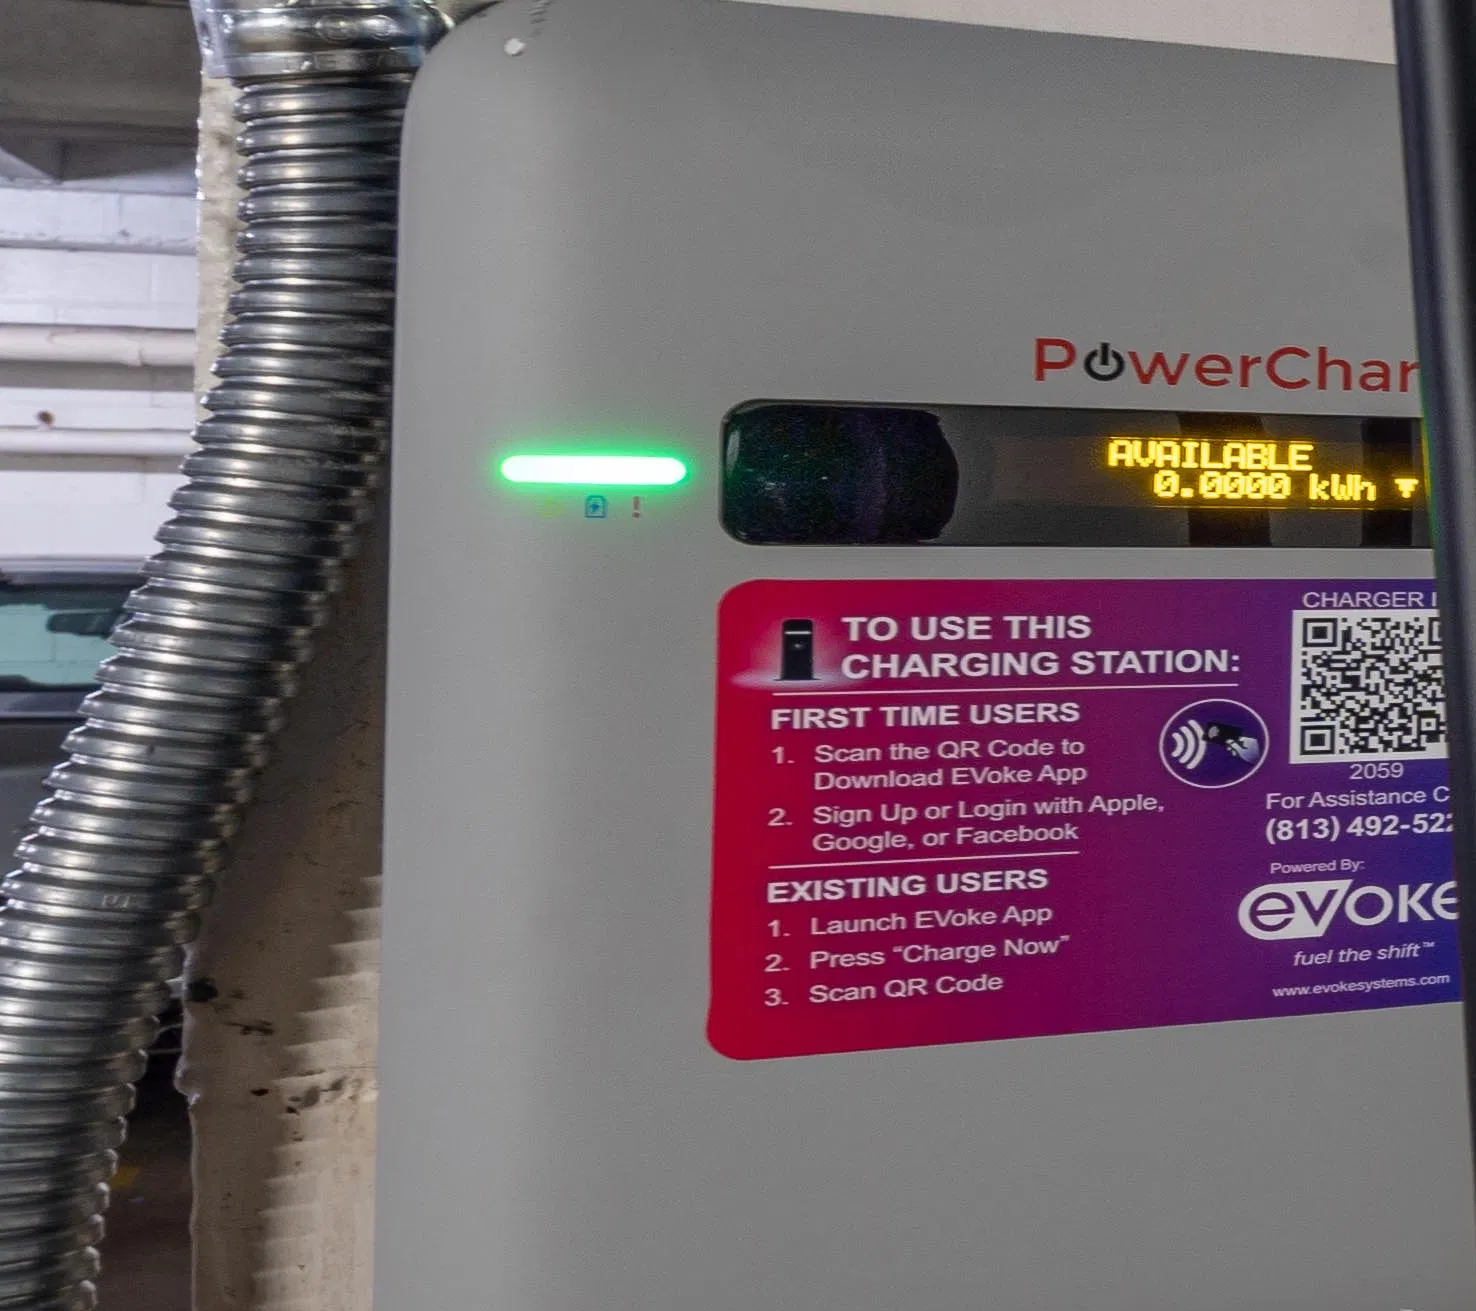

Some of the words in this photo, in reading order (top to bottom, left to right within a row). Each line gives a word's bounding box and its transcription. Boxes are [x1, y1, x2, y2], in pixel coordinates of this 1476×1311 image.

[1033, 337, 1421, 393] PowerChar
[1108, 439, 1313, 471] AVAILABLE
[1154, 470, 1291, 499] 0.0000
[1309, 473, 1377, 501] kWh
[1302, 591, 1424, 608] CHARGER
[840, 617, 898, 642] TO
[910, 616, 993, 641] USE
[1003, 615, 1092, 640] THIS
[840, 652, 1061, 679] CHARGING
[1070, 649, 1240, 675] STATION:
[771, 707, 872, 730] FIRST
[880, 705, 960, 727] TIME
[970, 703, 1080, 725] USERS
[771, 746, 795, 765] 1.
[814, 744, 882, 763] Scan
[889, 743, 930, 761] the
[937, 740, 981, 760] QR
[988, 739, 1055, 758] Code
[1062, 739, 1085, 756] to
[814, 768, 943, 790] Download
[951, 766, 1033, 786] EVoke
[1037, 764, 1088, 786] App
[1349, 762, 1404, 780] 2059
[767, 807, 793, 826] 2.
[813, 805, 872, 827] Sign
[880, 803, 918, 825] Up
[924, 805, 952, 820] or
[958, 799, 1027, 821] Login
[1033, 796, 1083, 815] with
[1088, 794, 1165, 816] Apple,
[1265, 792, 1305, 810] For
[1308, 789, 1427, 808] Assistance
[813, 830, 915, 853] Google,
[921, 832, 951, 847] or
[956, 823, 1080, 845] Facebook
[1265, 815, 1341, 845] (813)
[1269, 859, 1338, 874] Powered
[1340, 858, 1365, 872] By:
[767, 875, 927, 904] EXISTING
[936, 868, 1049, 895] USERS
[768, 919, 790, 938] 1.
[810, 913, 907, 936] Launch
[914, 907, 998, 929] EVoke
[1001, 905, 1053, 927] App
[764, 954, 790, 973] 2.
[809, 948, 885, 969] Press
[1293, 949, 1333, 966] fuel
[1338, 947, 1372, 963] the
[764, 988, 789, 1007] 3.
[809, 982, 877, 1004] Scan
[884, 978, 929, 998] QR
[935, 973, 1004, 995] Code
[1272, 973, 1451, 998] www.evokesystems.com
